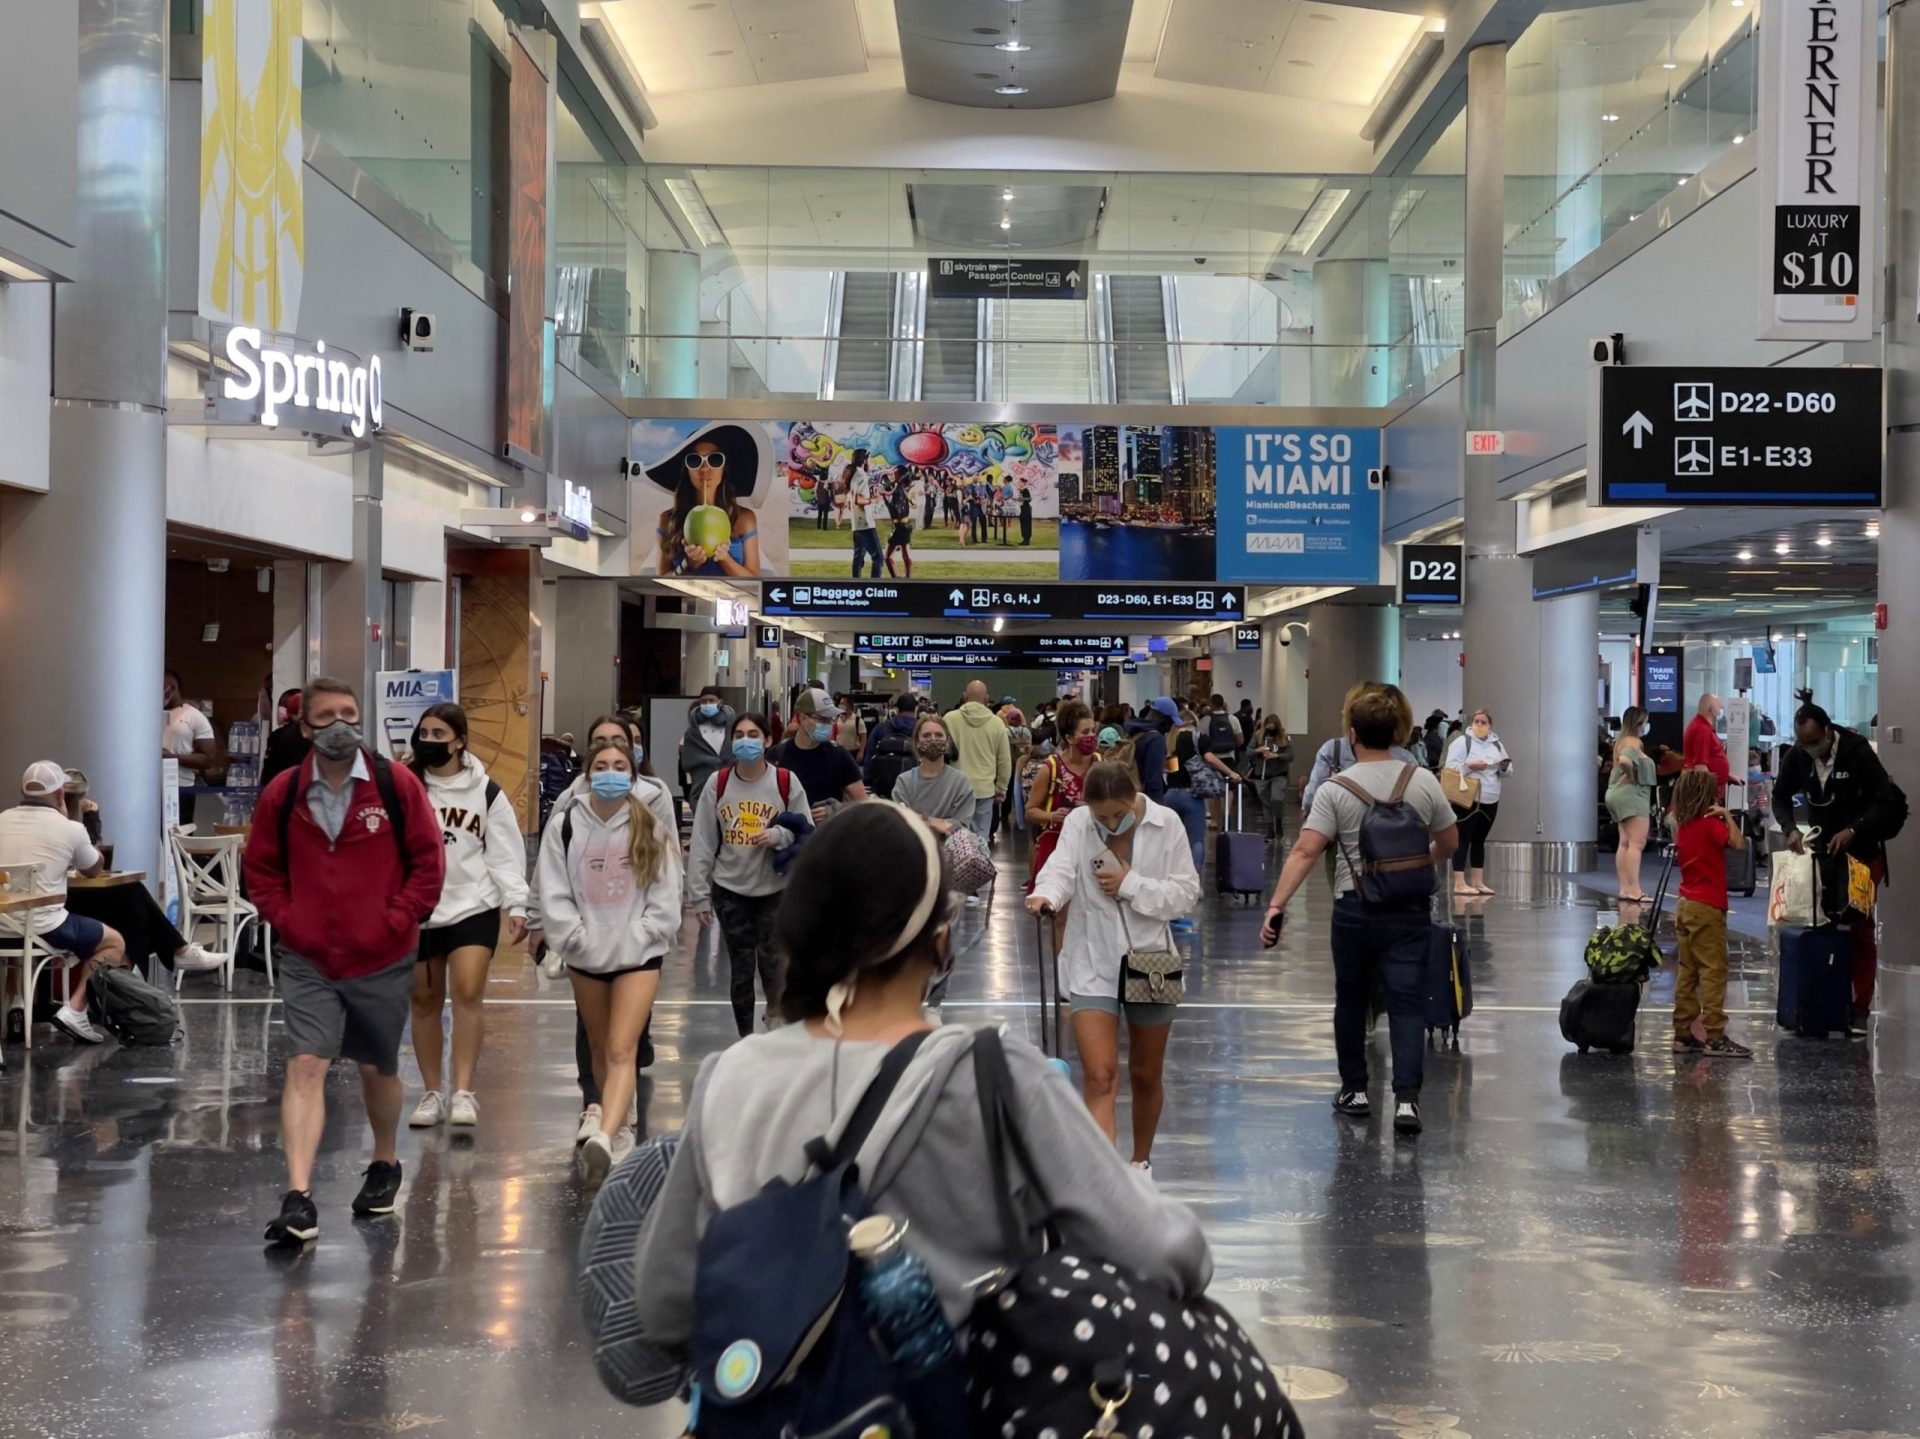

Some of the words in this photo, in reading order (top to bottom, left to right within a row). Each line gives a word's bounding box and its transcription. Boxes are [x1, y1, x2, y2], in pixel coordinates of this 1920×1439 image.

[1803, 0, 1841, 194] ERNER
[1787, 214, 1849, 228] LUXURY
[1807, 232, 1829, 246] AT
[954, 263, 987, 272] skytrain
[988, 263, 998, 271] to
[1783, 251, 1853, 289] $10
[968, 272, 1009, 281] Passport
[1010, 272, 1044, 280] Control
[224, 326, 367, 438] Spring
[1245, 433, 1302, 463] IT'S
[1309, 433, 1351, 463] SO
[1472, 434, 1497, 451] EXIT
[1245, 464, 1351, 495] MIAMI
[1246, 500, 1350, 510] MiamiandBeaches.com
[1249, 535, 1301, 550] MIAMI
[1409, 560, 1456, 581] D22
[813, 586, 863, 599] Baggage
[865, 587, 898, 598] Claim
[992, 593, 1000, 605] F,
[1003, 593, 1016, 605] G,
[1018, 593, 1031, 605] H,
[1033, 593, 1041, 604] J
[1153, 594, 1194, 605] E1-E33
[883, 636, 910, 646] EXIT
[925, 637, 953, 645] Terminal
[1238, 630, 1259, 640] D23
[906, 653, 929, 662] EXIT
[720, 804, 734, 823] PI
